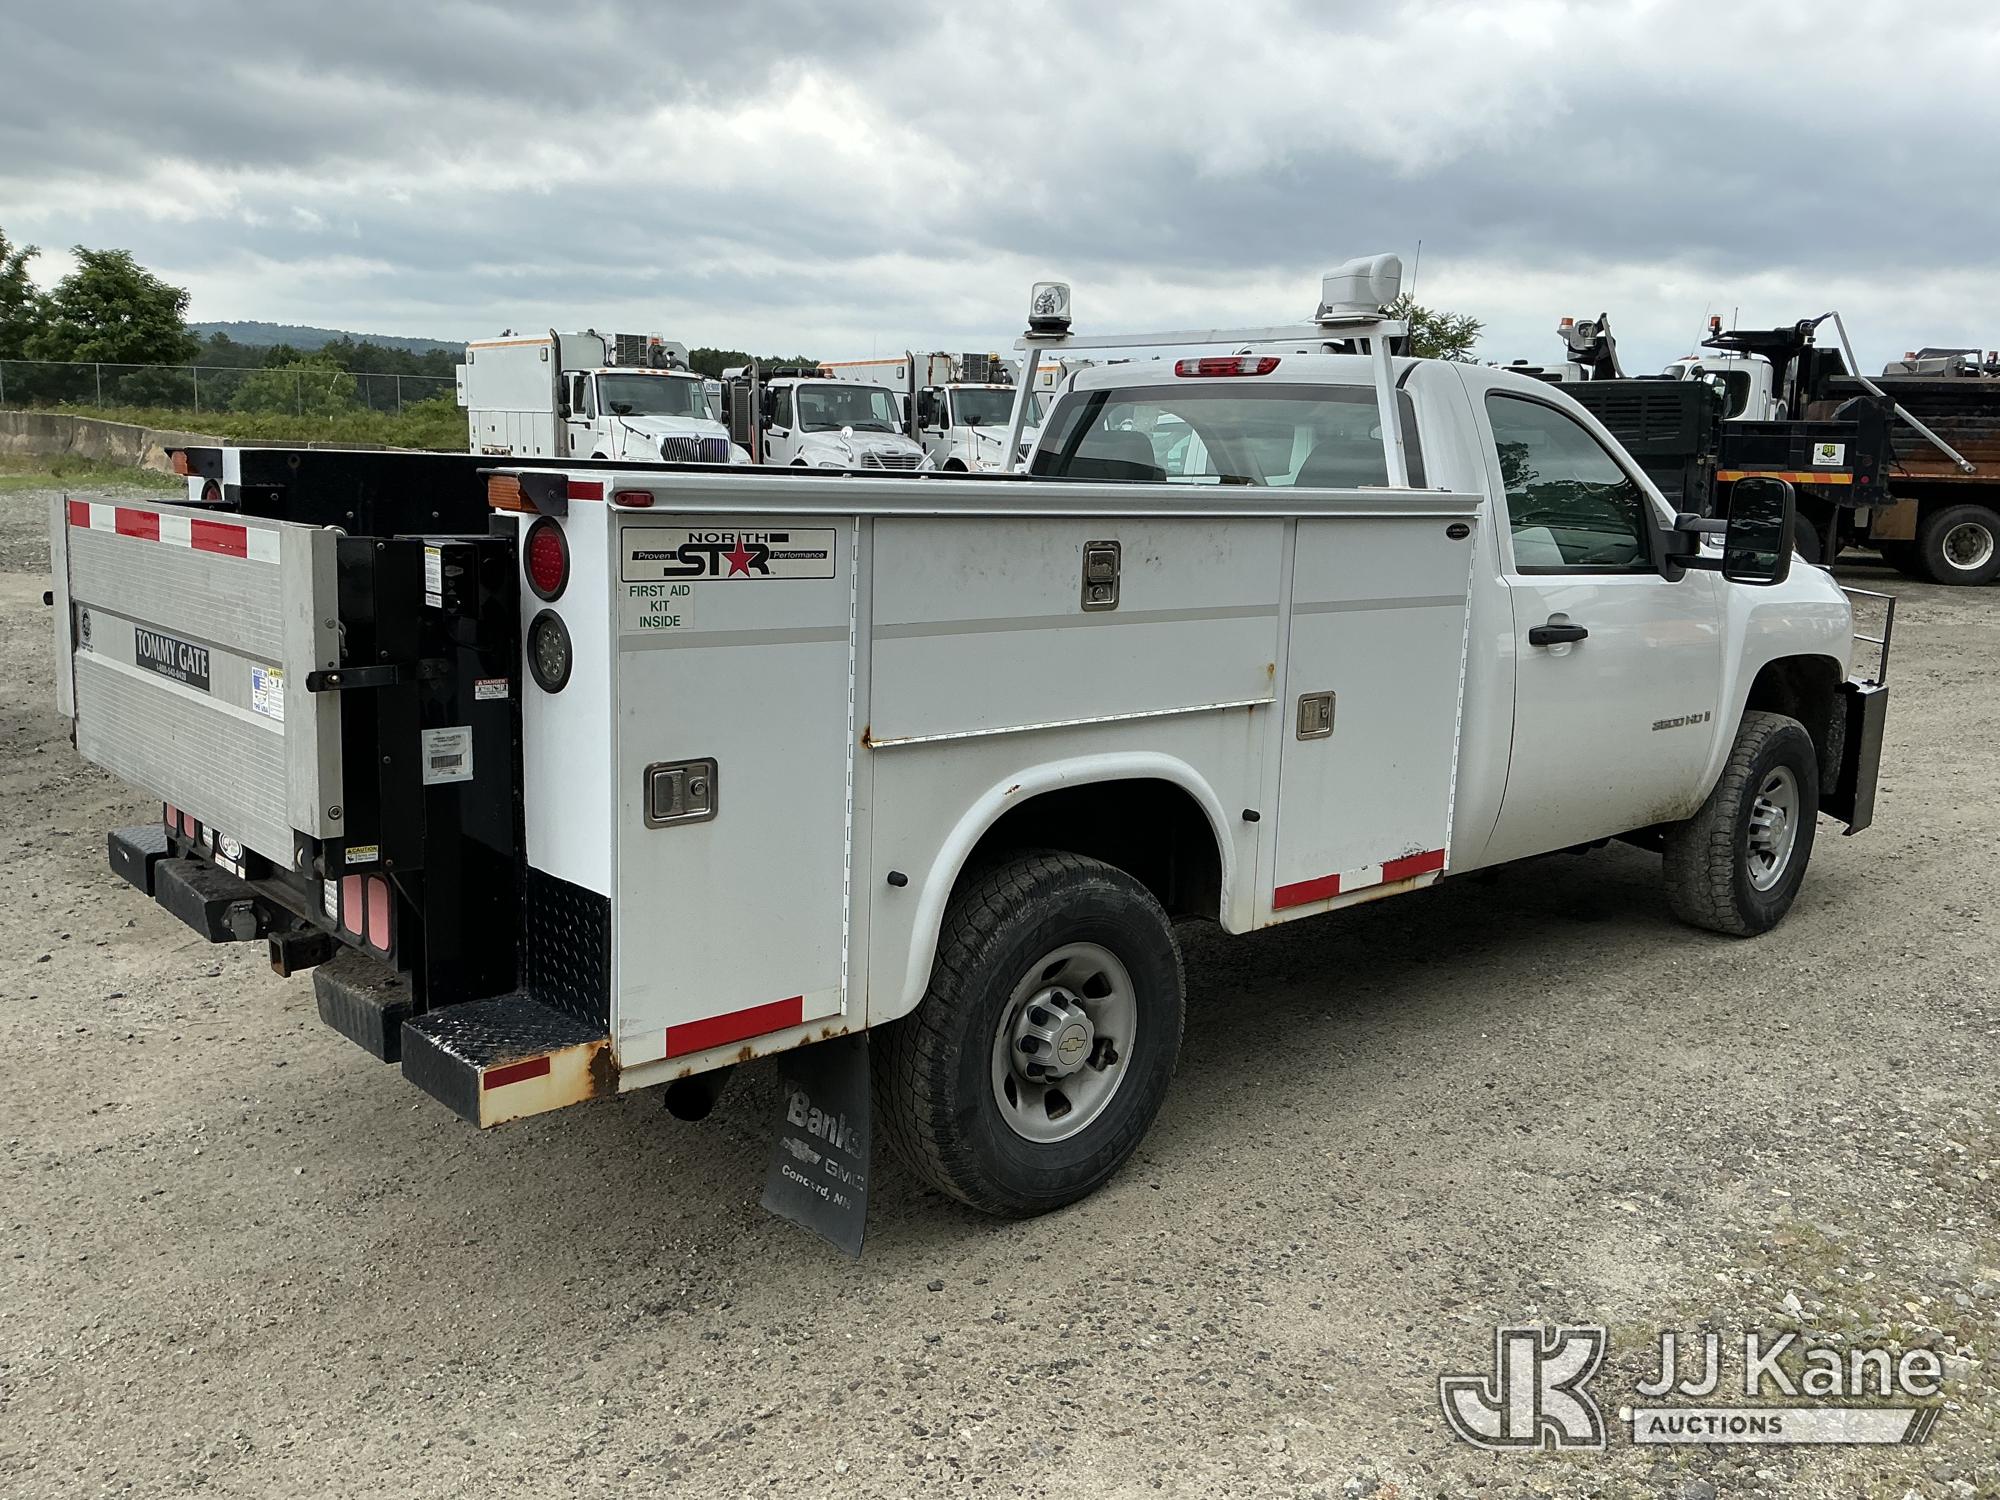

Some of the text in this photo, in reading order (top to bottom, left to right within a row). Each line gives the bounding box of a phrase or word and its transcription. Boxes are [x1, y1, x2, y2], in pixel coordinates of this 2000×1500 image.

[688, 533, 769, 543] NORTH
[638, 552, 671, 560] Proven
[773, 551, 825, 559] Performance
[629, 585, 690, 597] FIRST AID
[650, 600, 670, 612] KIT
[639, 615, 681, 627] INSIDE
[136, 630, 208, 678] TOMMY GATE
[786, 1091, 864, 1159] Banks
